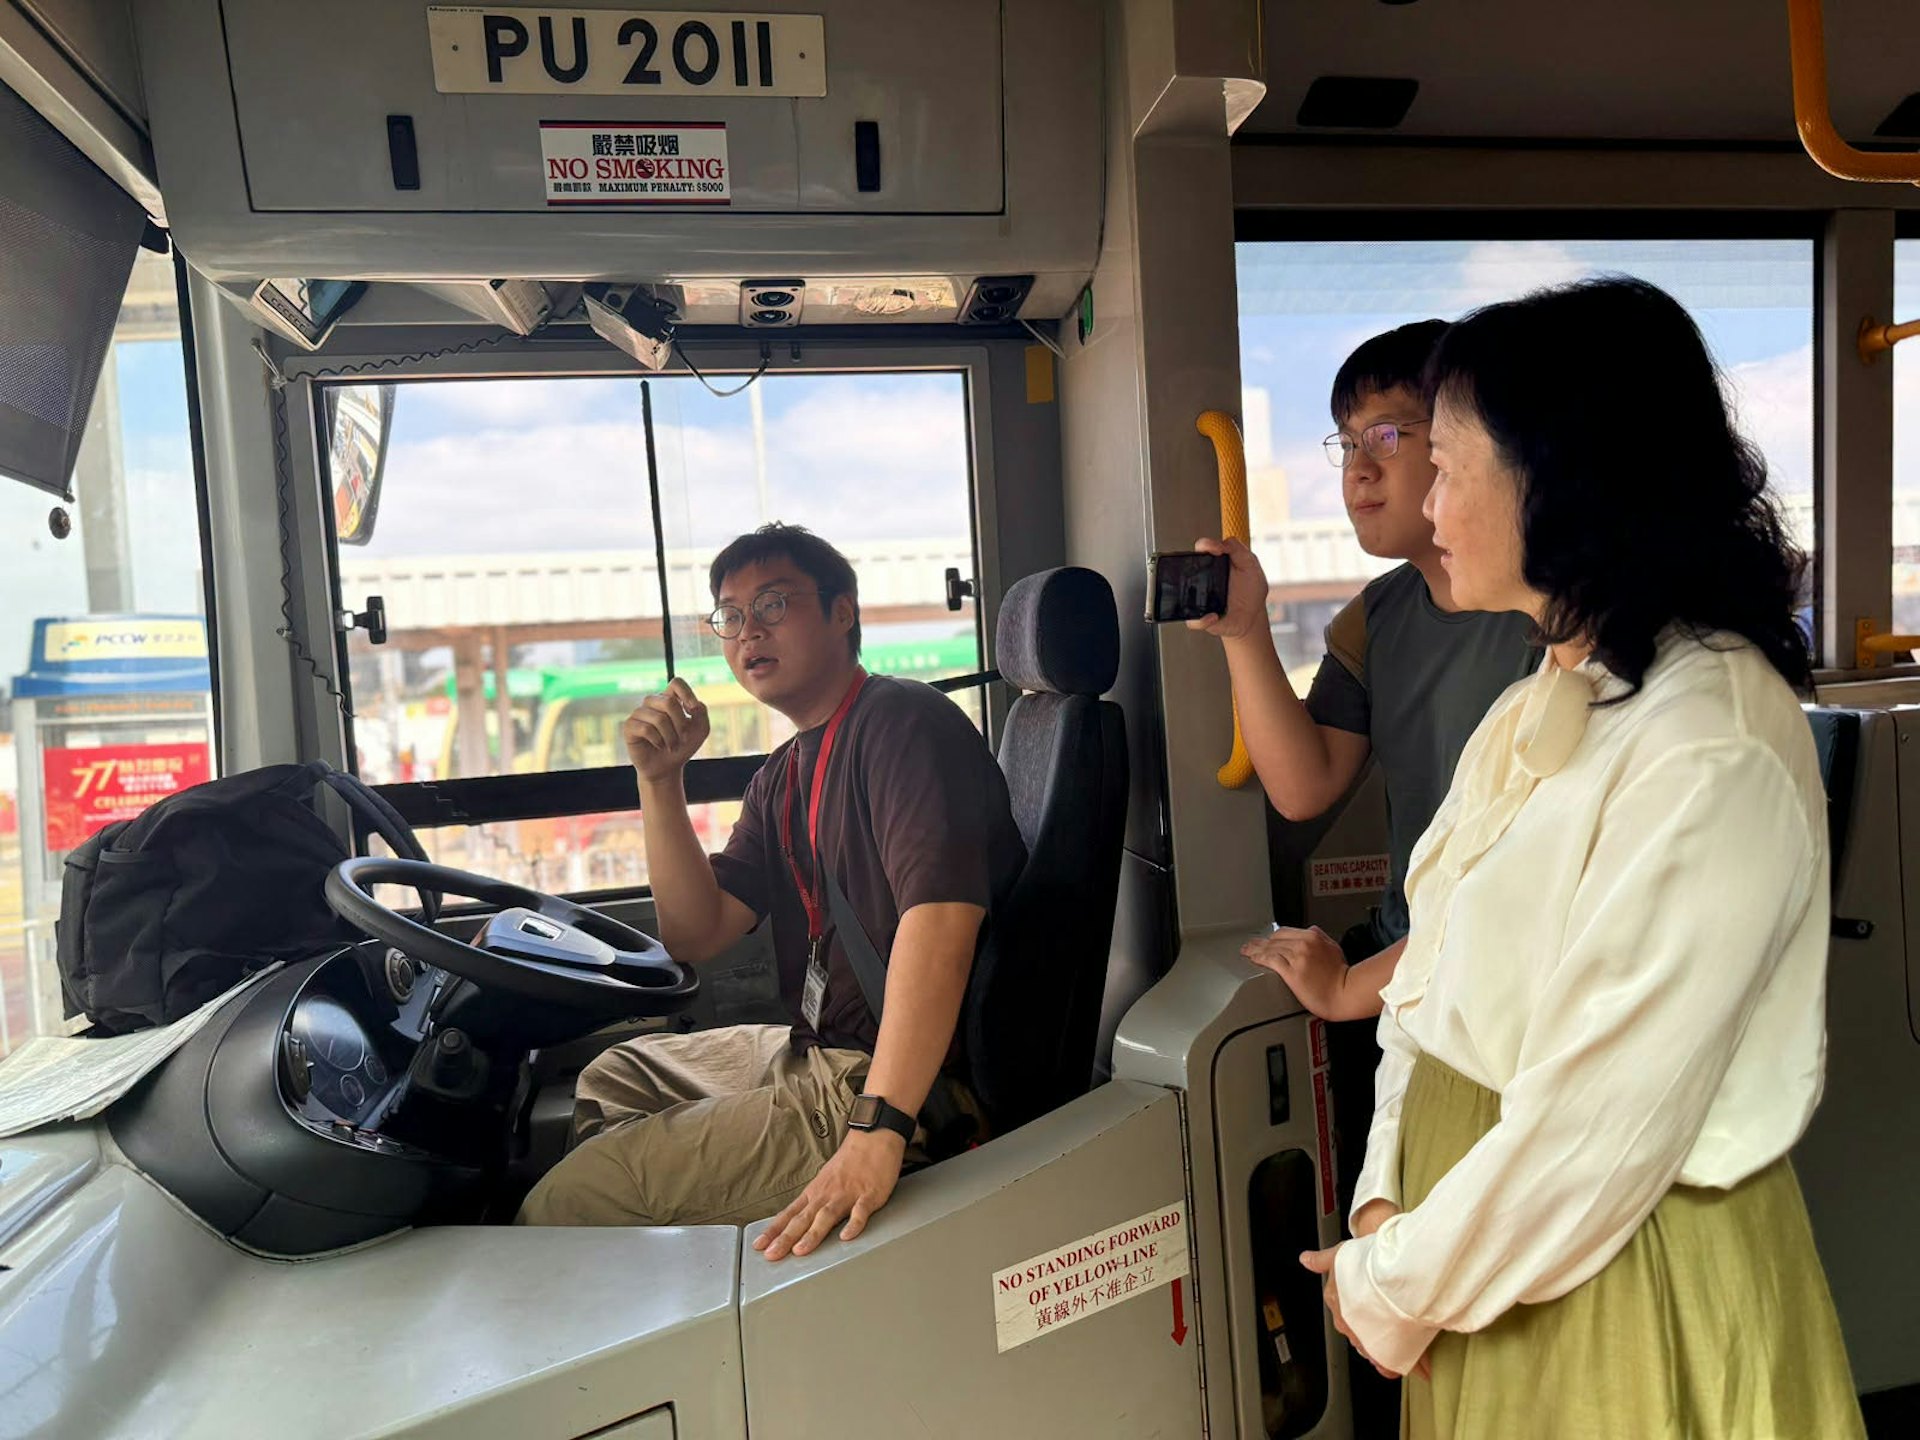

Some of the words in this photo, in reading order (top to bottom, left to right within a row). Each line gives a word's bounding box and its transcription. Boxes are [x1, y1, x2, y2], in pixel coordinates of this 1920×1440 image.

[483, 15, 588, 83] PU
[617, 18, 773, 86] 2011
[592, 134, 679, 156] 嚴禁吸烟
[548, 158, 589, 179] NO
[596, 157, 725, 180] SMOKING
[599, 183, 648, 192] MAXIMUM
[651, 183, 695, 192] PENALTY:
[697, 183, 724, 192] $5000
[71, 760, 117, 798] 77
[1314, 861, 1349, 876] SEATING
[1349, 858, 1388, 873] CAPACITY
[999, 1273, 1023, 1294] NO
[1026, 1240, 1105, 1283] STANDING
[1109, 1211, 1180, 1250] FORWARD
[1029, 1281, 1051, 1305] OF
[1035, 1266, 1156, 1330] 黃線外不准企立
